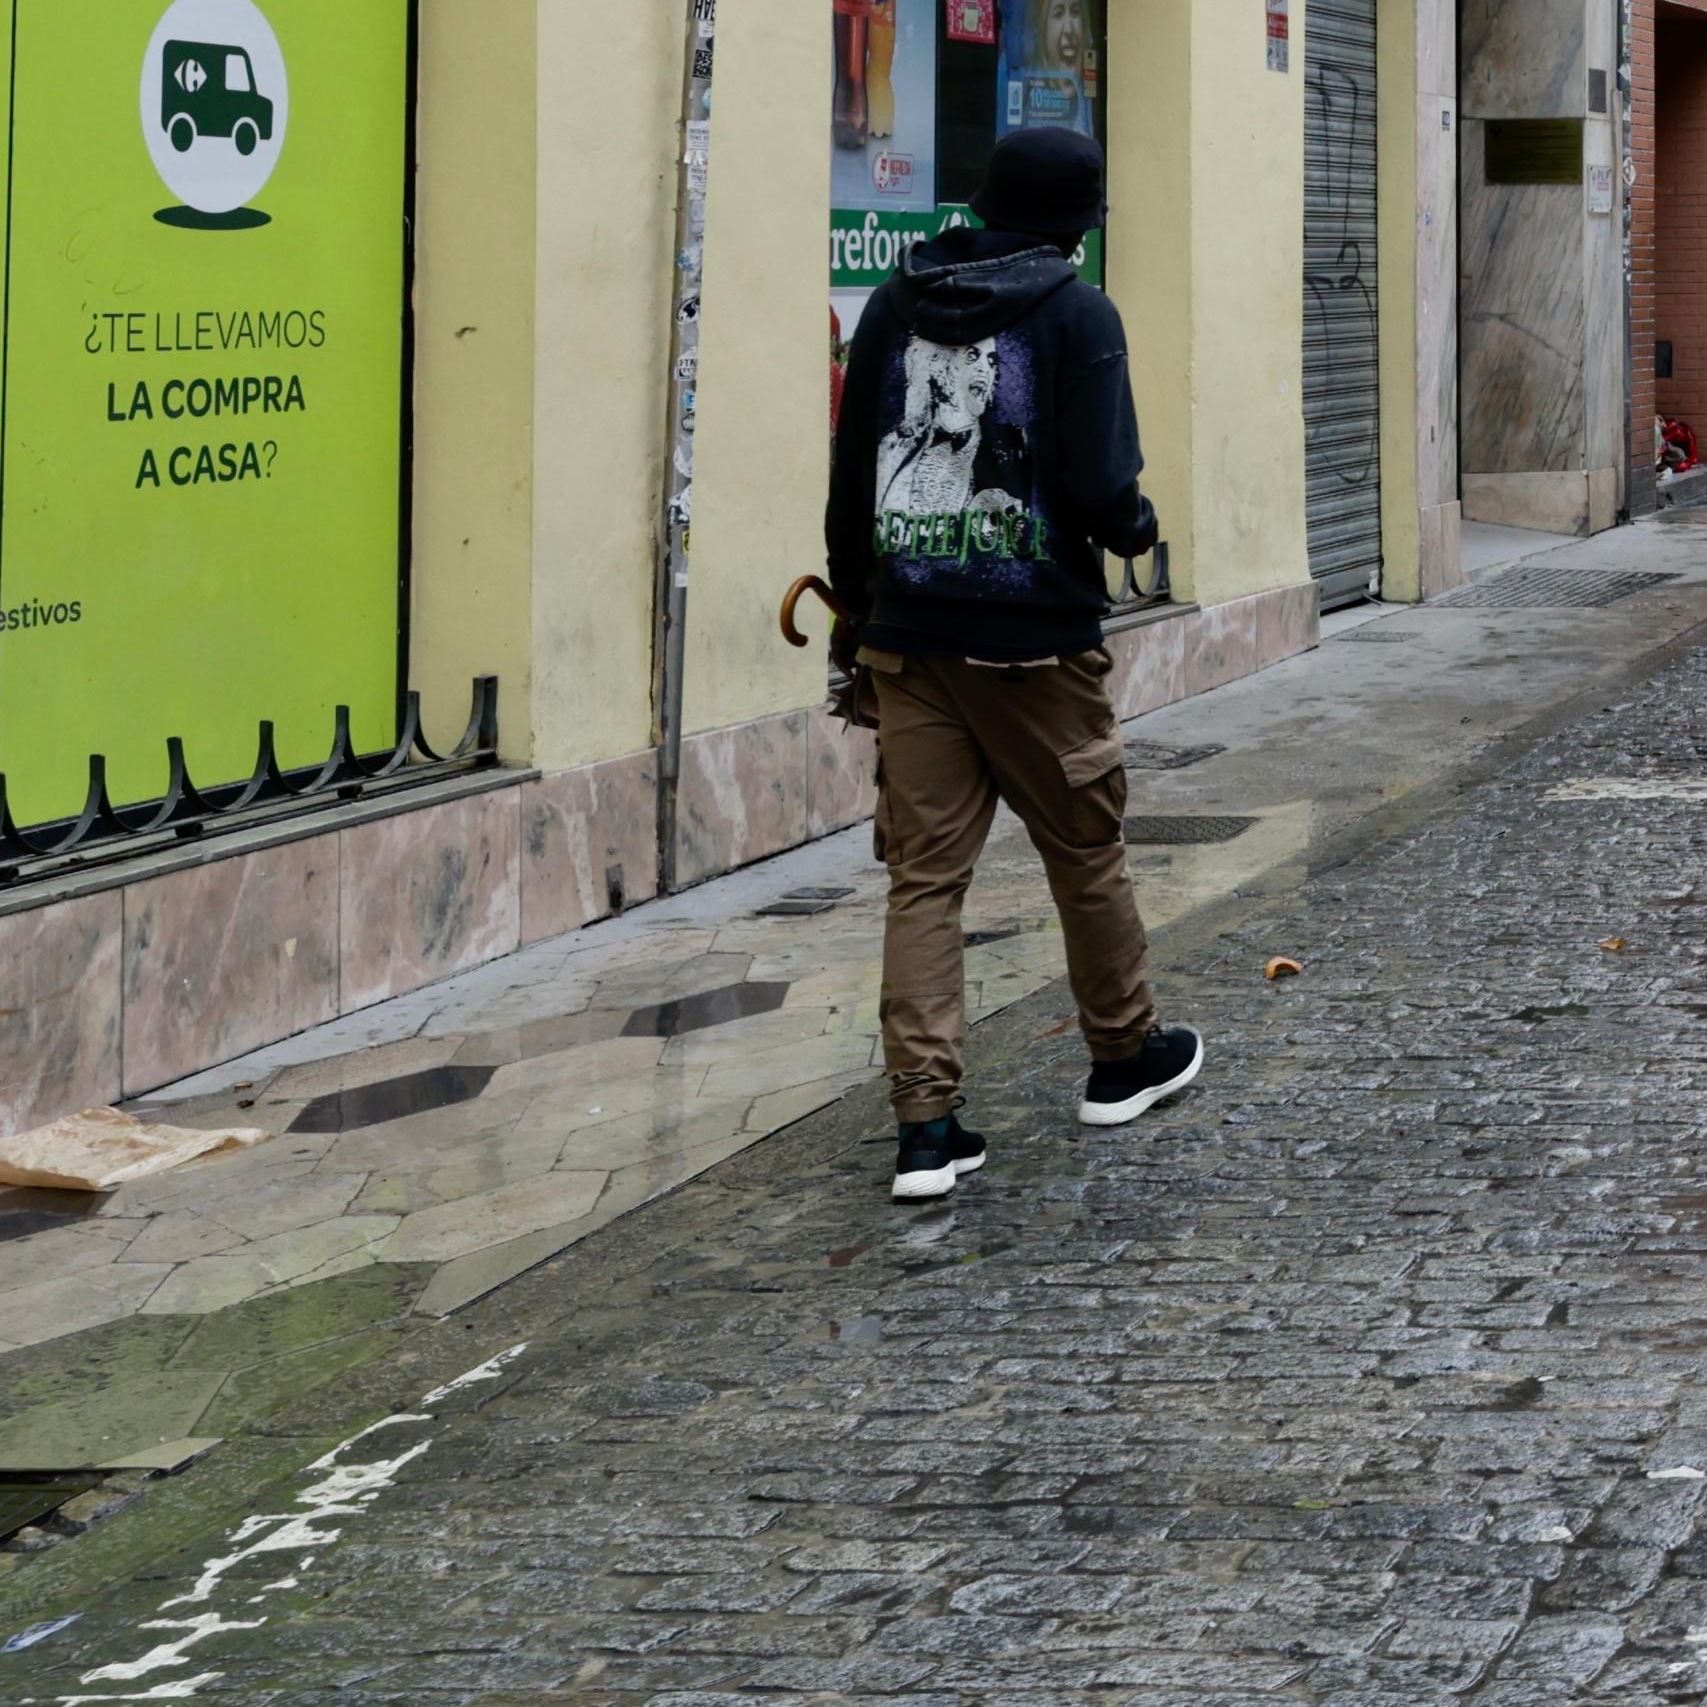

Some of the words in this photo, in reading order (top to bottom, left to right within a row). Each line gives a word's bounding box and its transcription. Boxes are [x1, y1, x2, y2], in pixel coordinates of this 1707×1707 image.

[85, 312, 146, 354] ¿TE
[156, 310, 326, 351] LLEVAMOS
[107, 380, 154, 422] LA
[161, 374, 306, 419] COMPRA
[135, 448, 160, 489] A
[168, 440, 278, 487] CASA?
